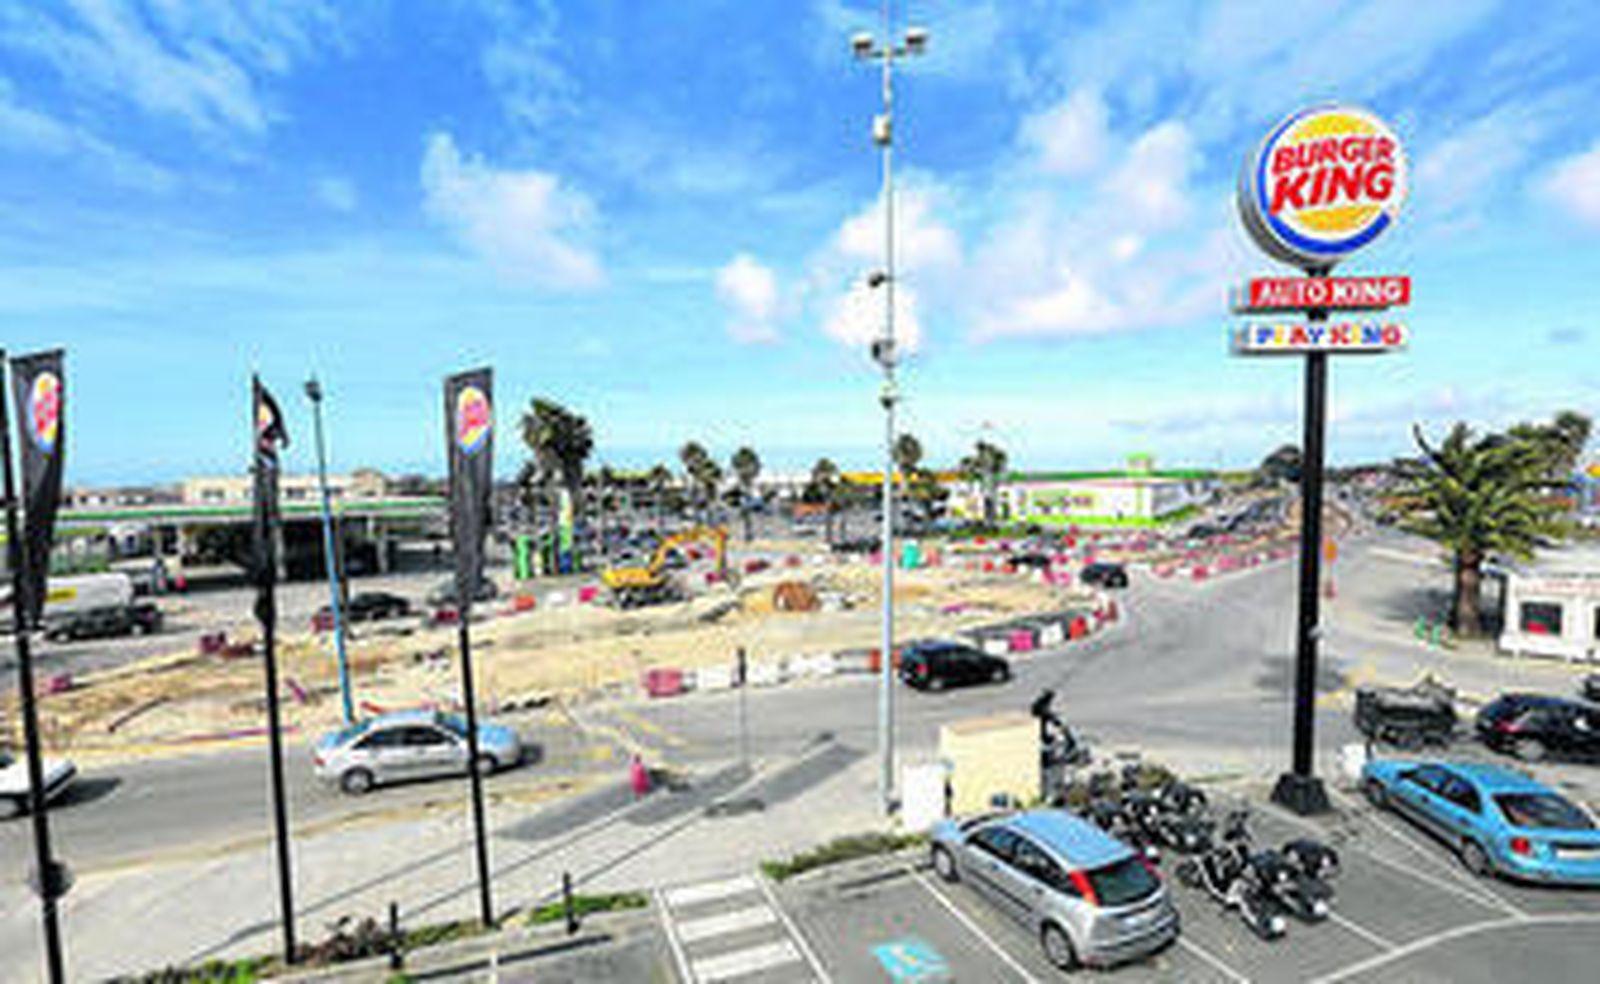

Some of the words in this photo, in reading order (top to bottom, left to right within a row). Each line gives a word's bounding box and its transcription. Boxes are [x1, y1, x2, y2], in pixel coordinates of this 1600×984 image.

[1272, 137, 1395, 175] BURGER
[1270, 163, 1393, 216] KING
[1257, 280, 1329, 304] AUTO
[1331, 279, 1403, 304] KING
[1257, 324, 1325, 346] PLAY
[1331, 323, 1402, 346] KING
